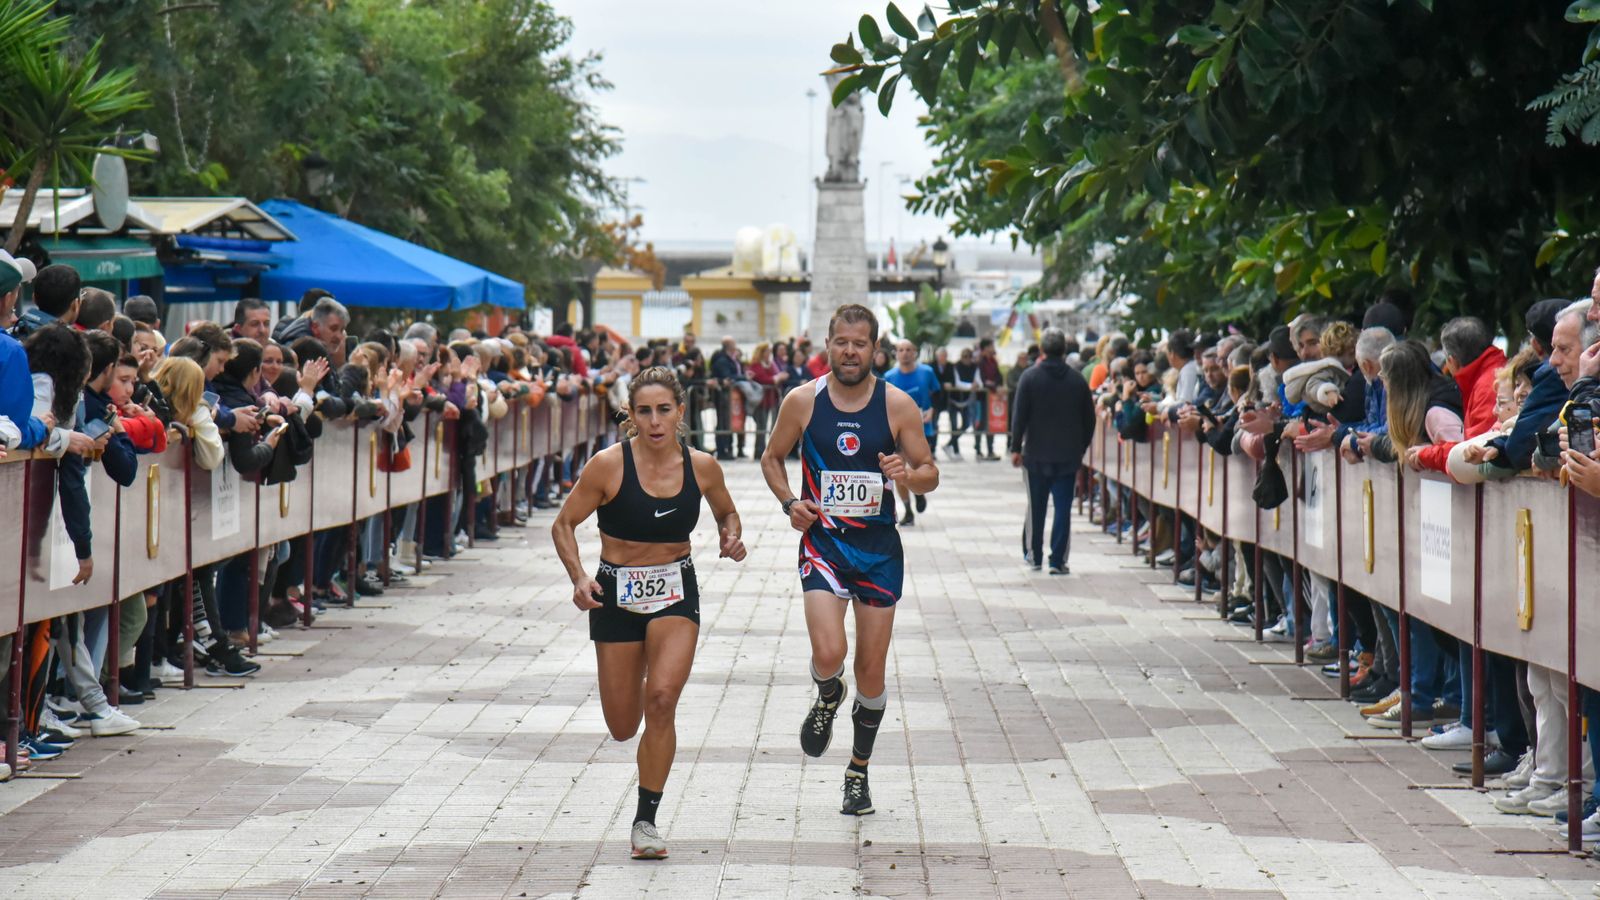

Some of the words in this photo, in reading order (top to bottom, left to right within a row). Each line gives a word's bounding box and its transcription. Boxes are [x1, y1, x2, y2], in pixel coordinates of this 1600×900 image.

[831, 475, 850, 483] XIV
[836, 484, 867, 501] 310
[628, 571, 648, 580] XIV
[634, 578, 666, 598] 352
